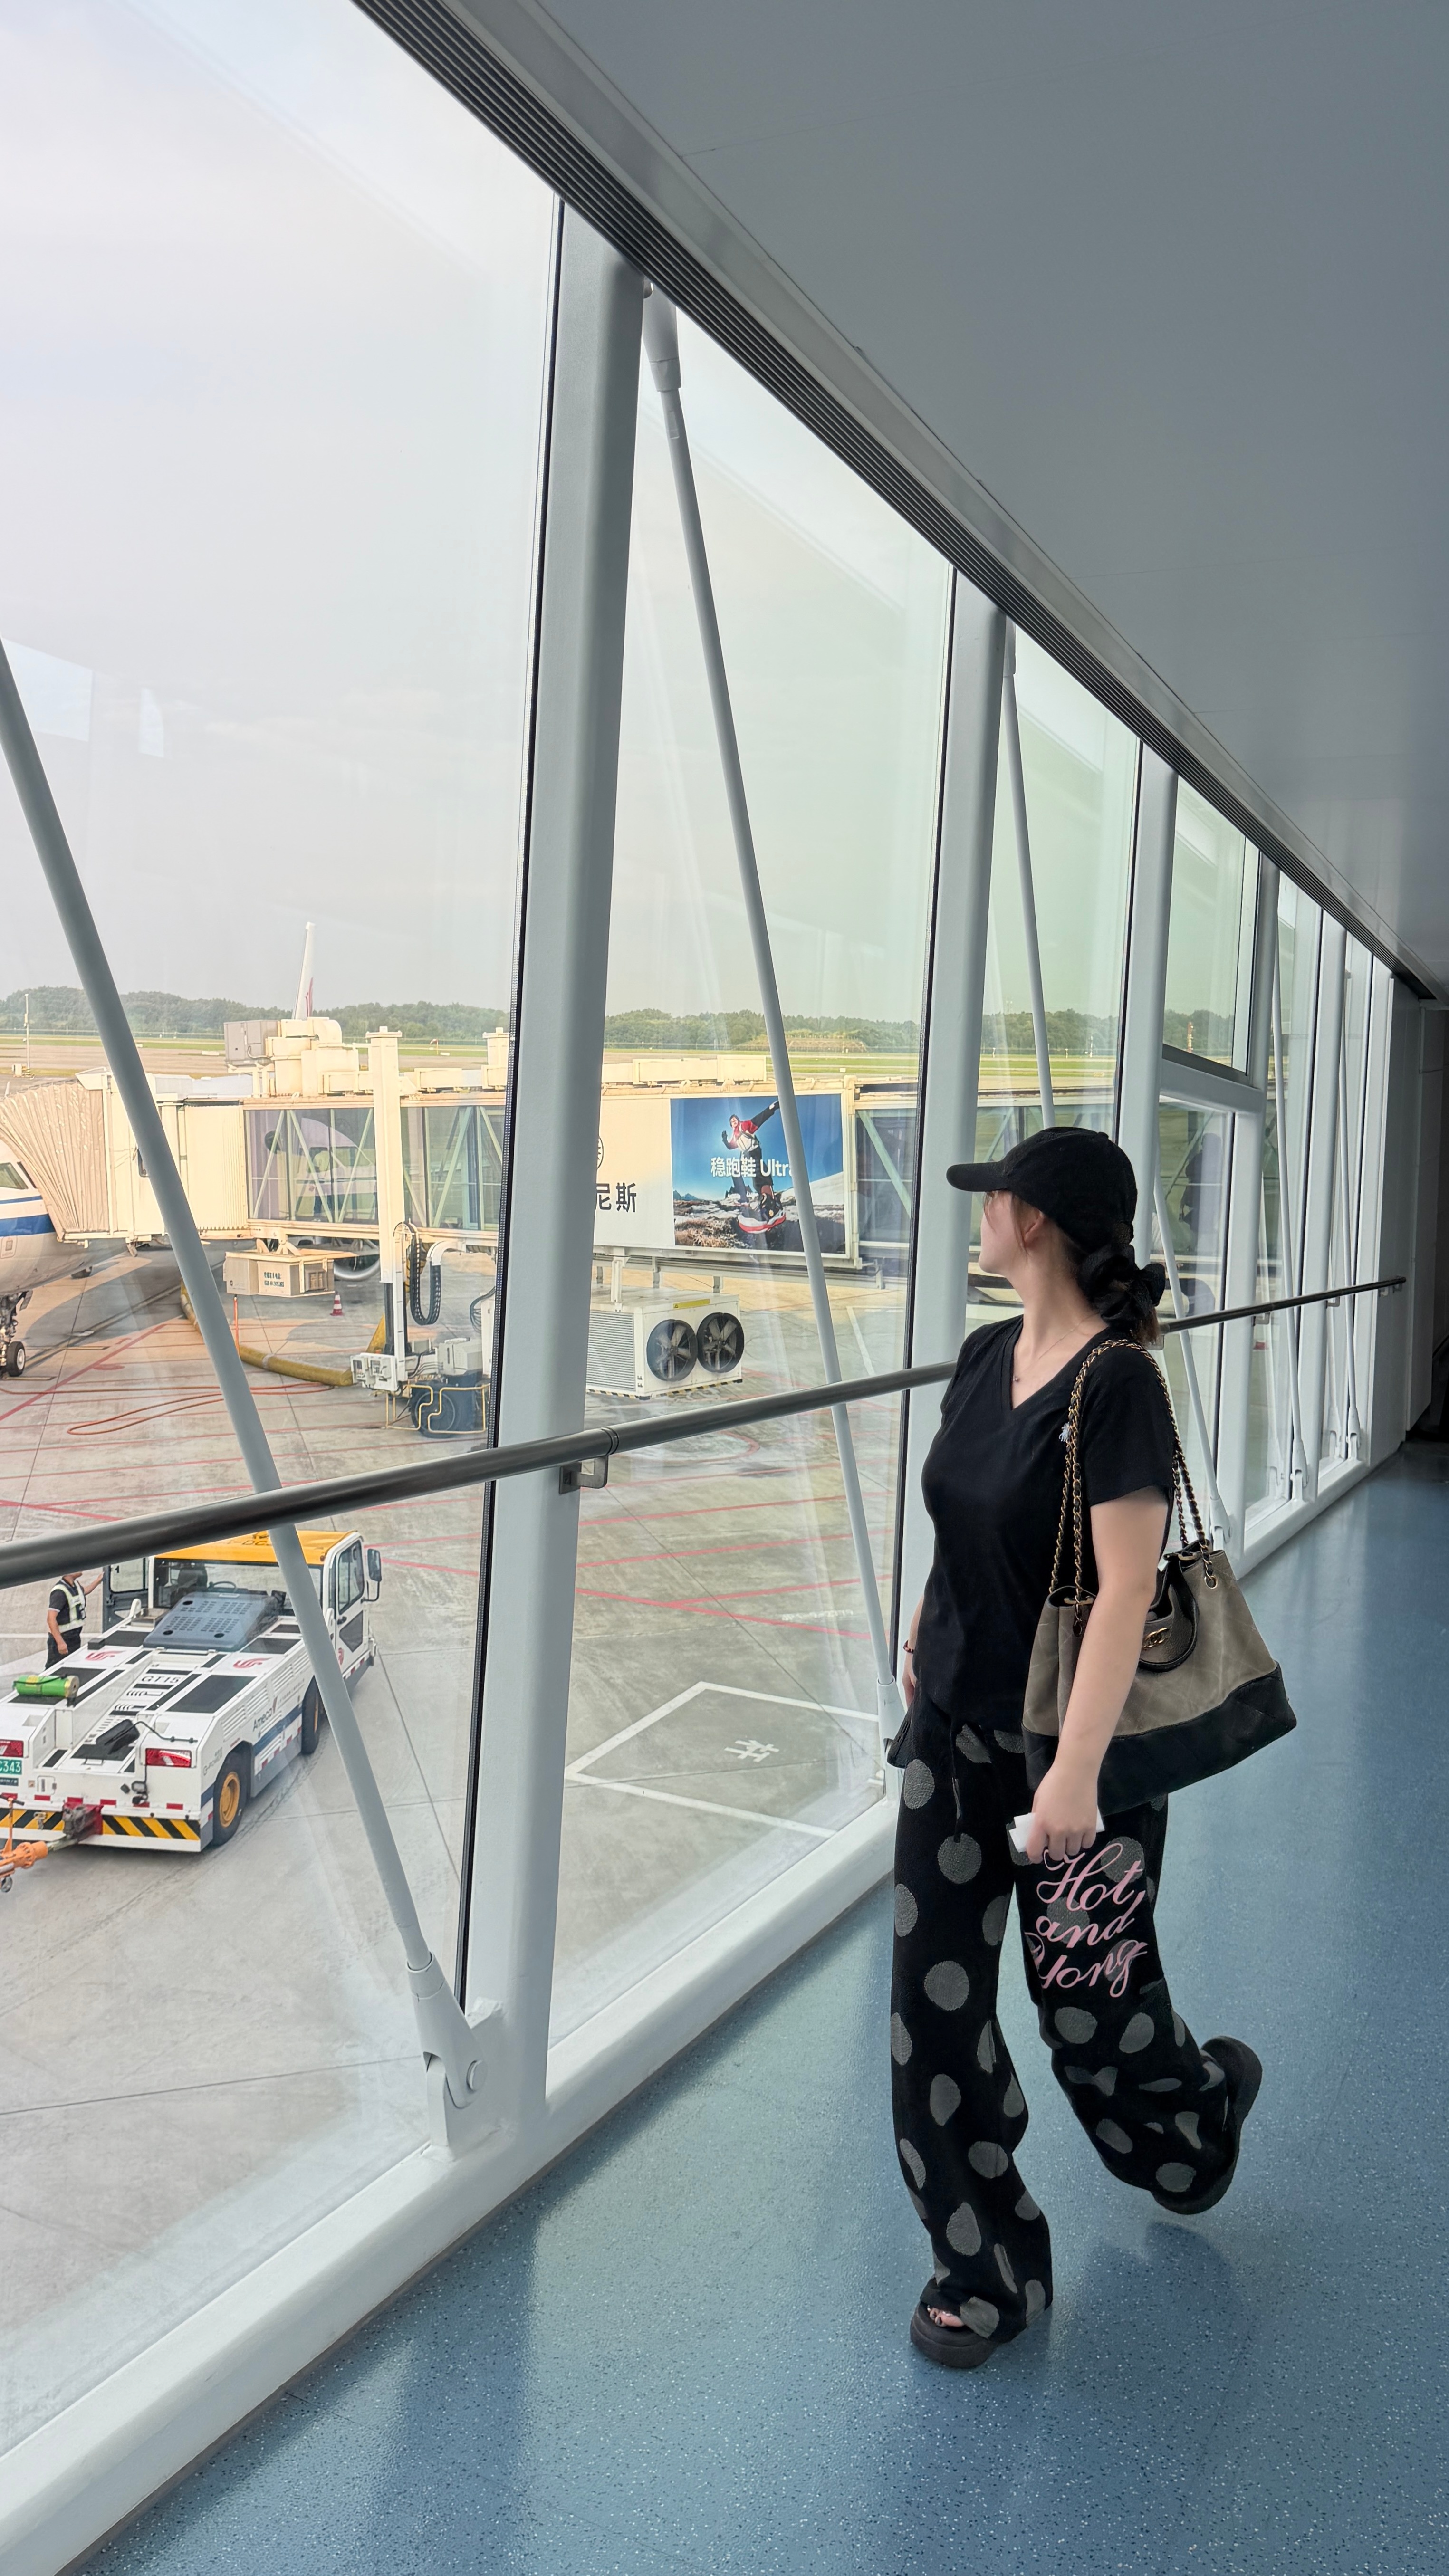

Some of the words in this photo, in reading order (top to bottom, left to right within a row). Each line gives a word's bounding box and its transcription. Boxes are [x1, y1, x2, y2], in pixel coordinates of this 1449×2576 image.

[710, 1157, 756, 1178] 稳跑鞋
[760, 1159, 792, 1177] Ultr
[1036, 1842, 1143, 1912] Hot
[1036, 1890, 1146, 1948] and
